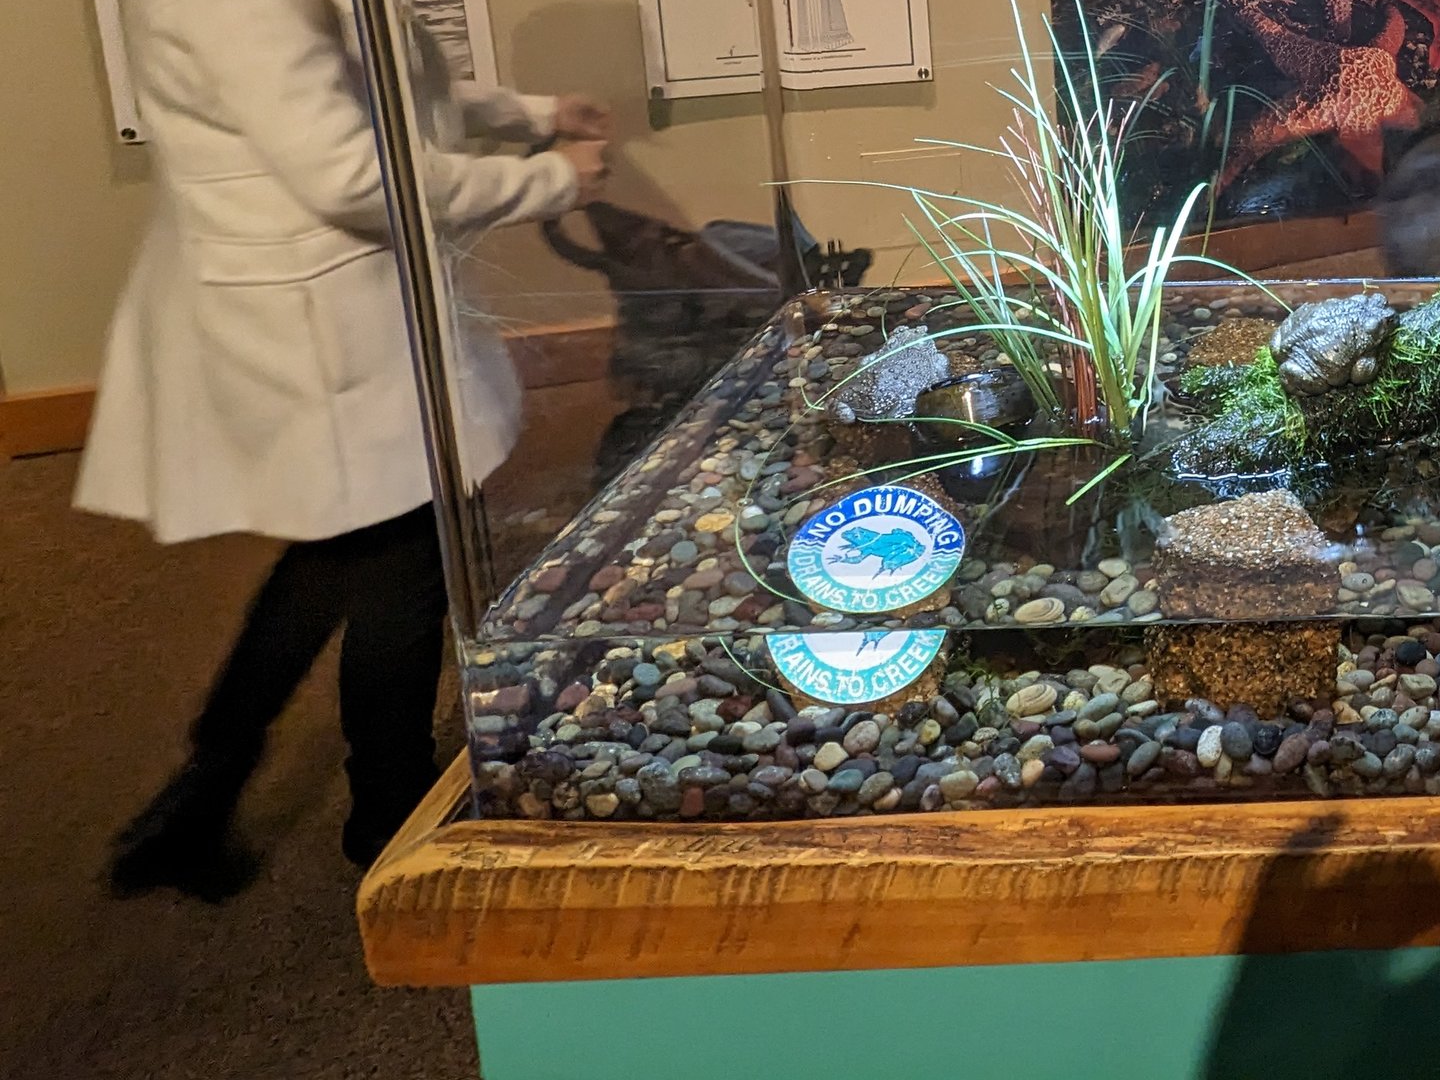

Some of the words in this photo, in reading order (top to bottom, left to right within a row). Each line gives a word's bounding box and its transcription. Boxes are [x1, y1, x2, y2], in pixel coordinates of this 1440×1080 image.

[808, 512, 848, 538] NO
[853, 494, 960, 546] DUMPING
[772, 634, 832, 690] RAINS
